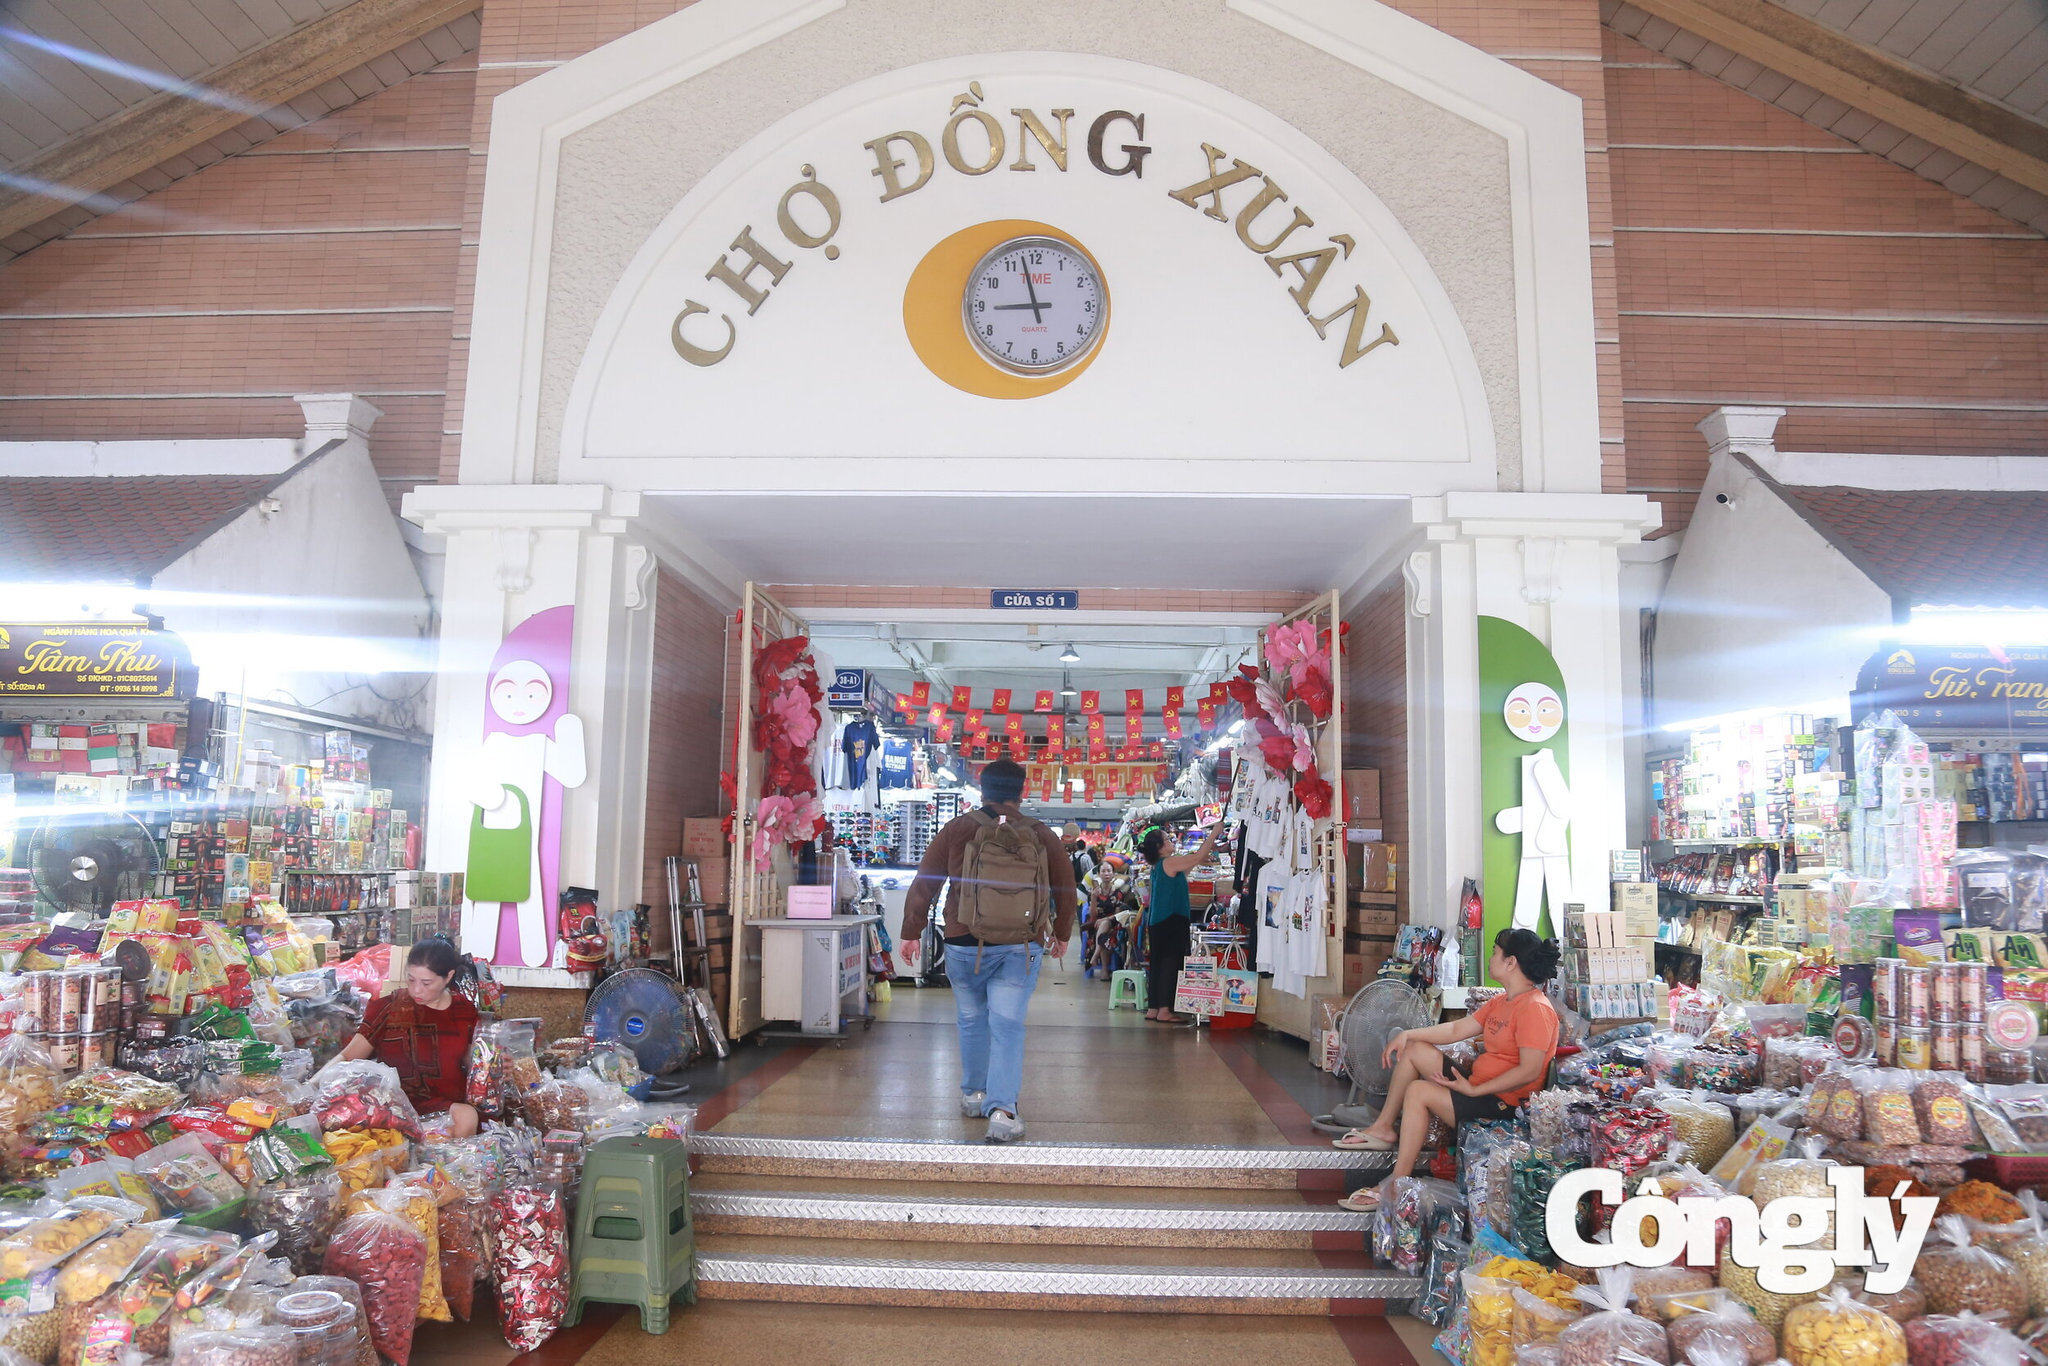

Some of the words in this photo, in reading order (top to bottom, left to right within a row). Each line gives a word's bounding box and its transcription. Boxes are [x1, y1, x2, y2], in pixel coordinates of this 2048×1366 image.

[671, 164, 841, 366] CHỢ
[863, 81, 1151, 203] ĐỒNG
[1168, 142, 1399, 368] XUÂN
[1029, 253, 1042, 265] 12
[1058, 259, 1063, 271] 1
[1005, 260, 1017, 272] 11
[986, 277, 999, 289] 10
[1077, 276, 1084, 288] 2
[978, 300, 985, 312] 9
[1084, 300, 1091, 312] 3
[986, 324, 993, 336] 8
[1076, 324, 1084, 335] 4
[1006, 341, 1013, 353] 7
[1056, 341, 1063, 353] 5
[1031, 348, 1038, 360] 6
[1004, 593, 1032, 606] CỬA
[1035, 593, 1055, 606] SỐ
[1058, 596, 1065, 606] 1
[99, 628, 118, 636] HOA
[18, 640, 92, 675] Tâm
[94, 640, 162, 675] Thu
[37, 683, 45, 691] A1
